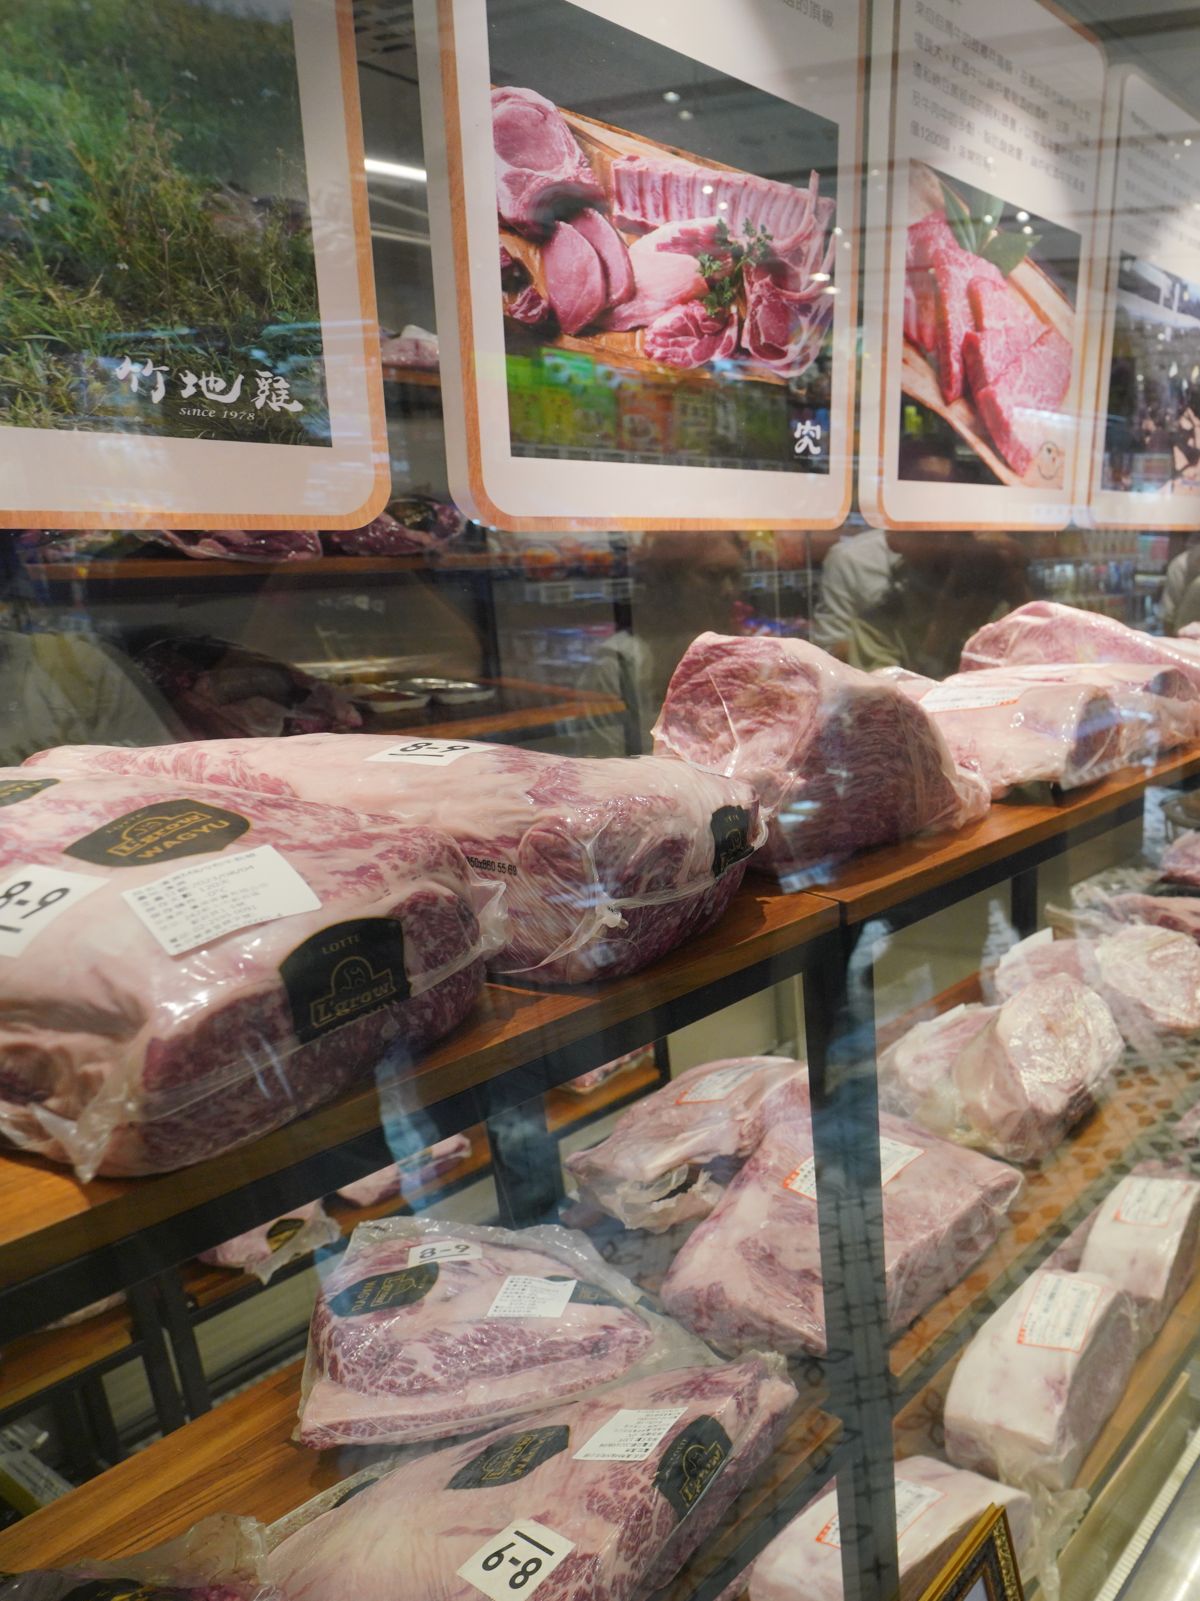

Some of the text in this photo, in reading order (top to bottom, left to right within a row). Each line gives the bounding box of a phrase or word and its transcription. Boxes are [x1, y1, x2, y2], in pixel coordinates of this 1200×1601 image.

[115, 355, 304, 412] 竹地雞
[178, 407, 256, 421] since 1978
[400, 742, 470, 753] 8-9
[136, 819, 231, 858] WAGYU
[419, 1244, 471, 1260] 8-9
[481, 1542, 543, 1590] 8-9
